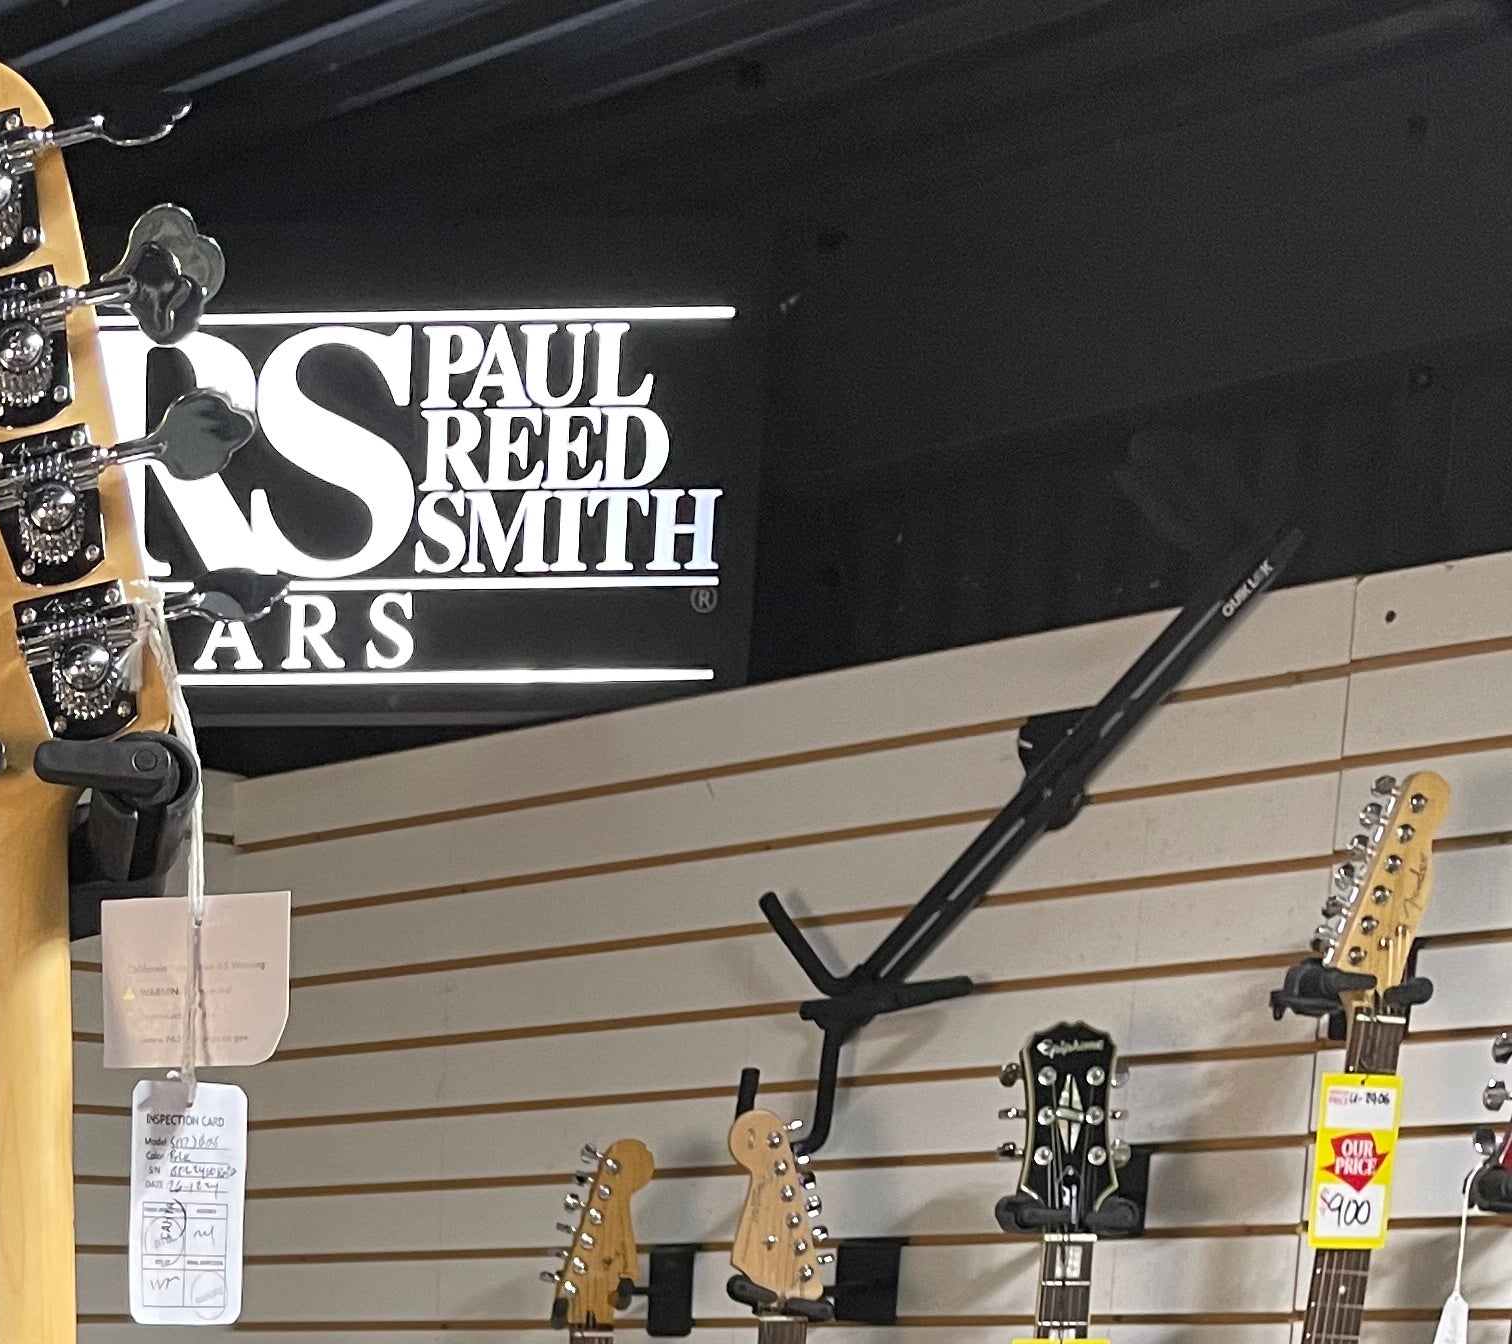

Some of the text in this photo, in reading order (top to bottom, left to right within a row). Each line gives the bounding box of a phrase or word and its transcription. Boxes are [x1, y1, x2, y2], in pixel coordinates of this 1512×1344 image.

[423, 322, 654, 409] PAUL
[420, 406, 670, 492] REED
[414, 488, 724, 574] SMITH
[147, 1113, 224, 1128] INSPECTION CARD
[145, 1137, 167, 1147] Model
[1341, 1139, 1373, 1156] OUR
[146, 1151, 164, 1160] Color
[1334, 1157, 1378, 1175] PRICE
[145, 1180, 163, 1189] DATE
